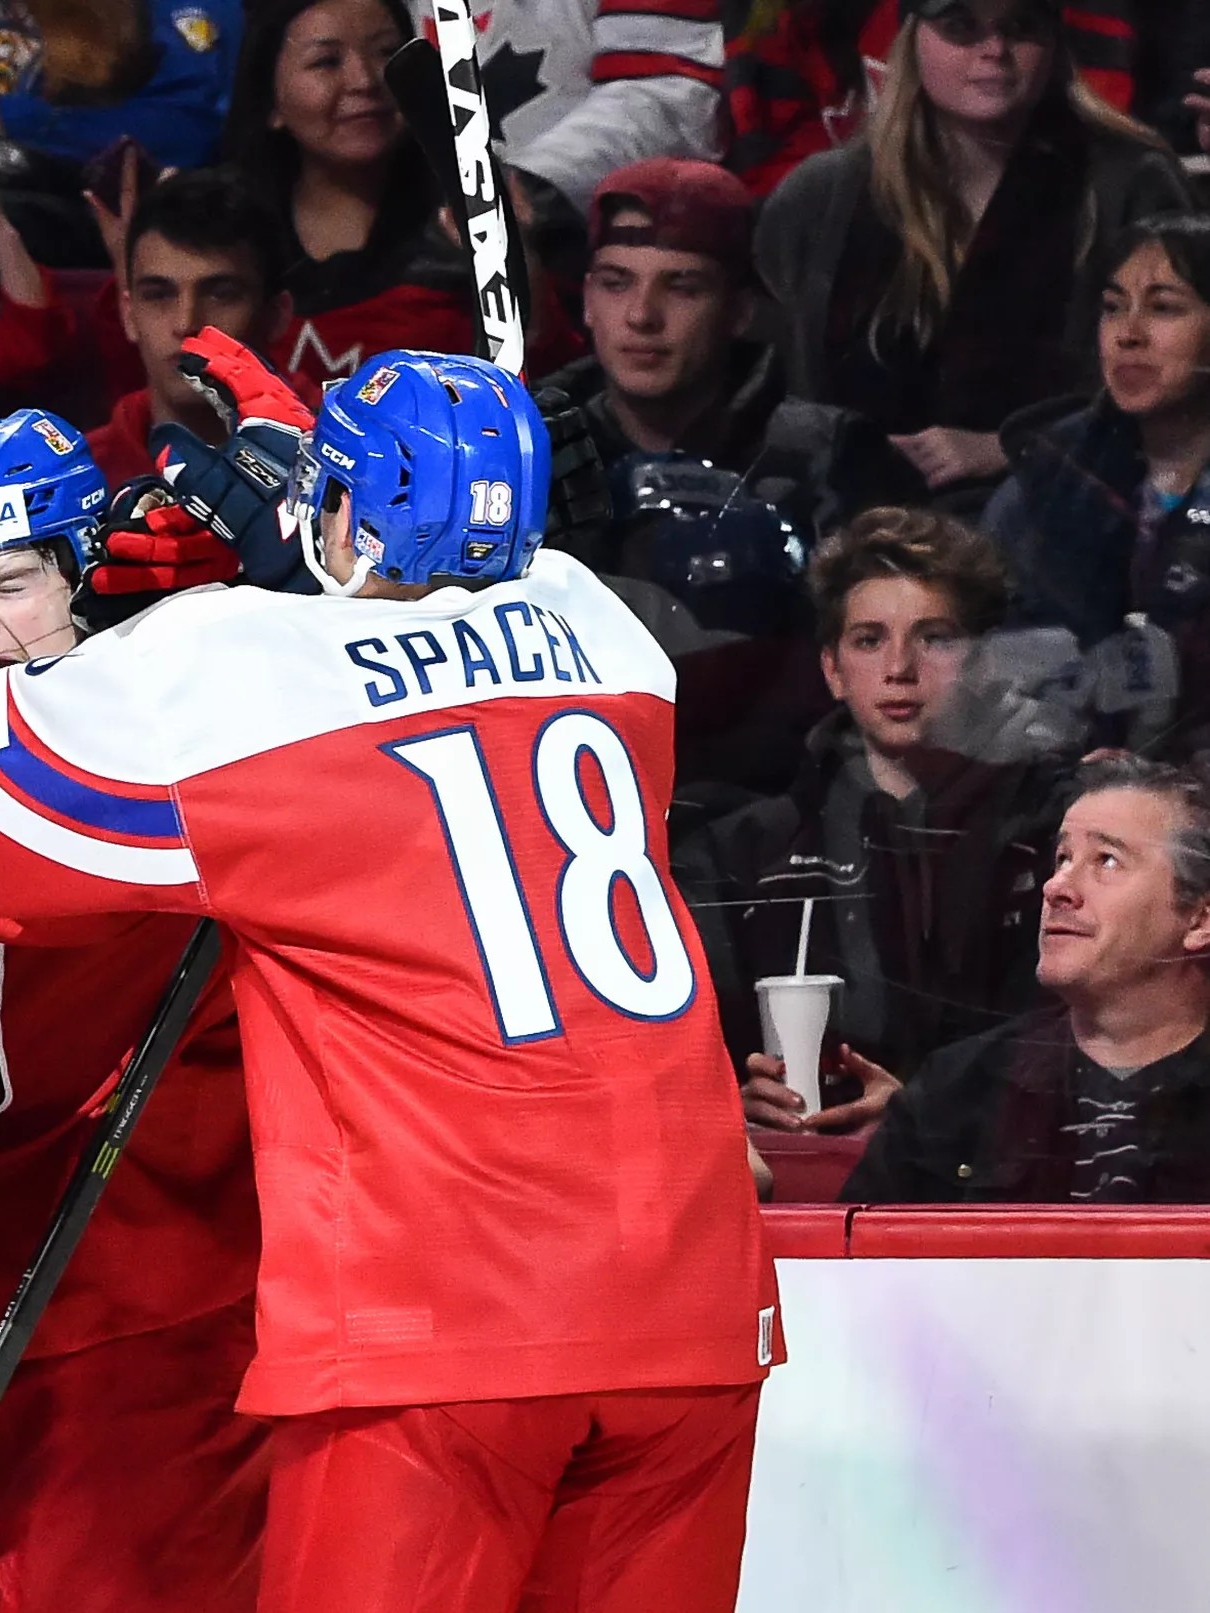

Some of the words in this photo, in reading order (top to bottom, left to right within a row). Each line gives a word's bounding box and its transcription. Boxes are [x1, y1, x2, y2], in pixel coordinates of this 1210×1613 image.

[321, 442, 356, 470] CCM
[469, 480, 512, 526] 18
[344, 601, 602, 707] SPACEK
[377, 708, 696, 1046] 18
